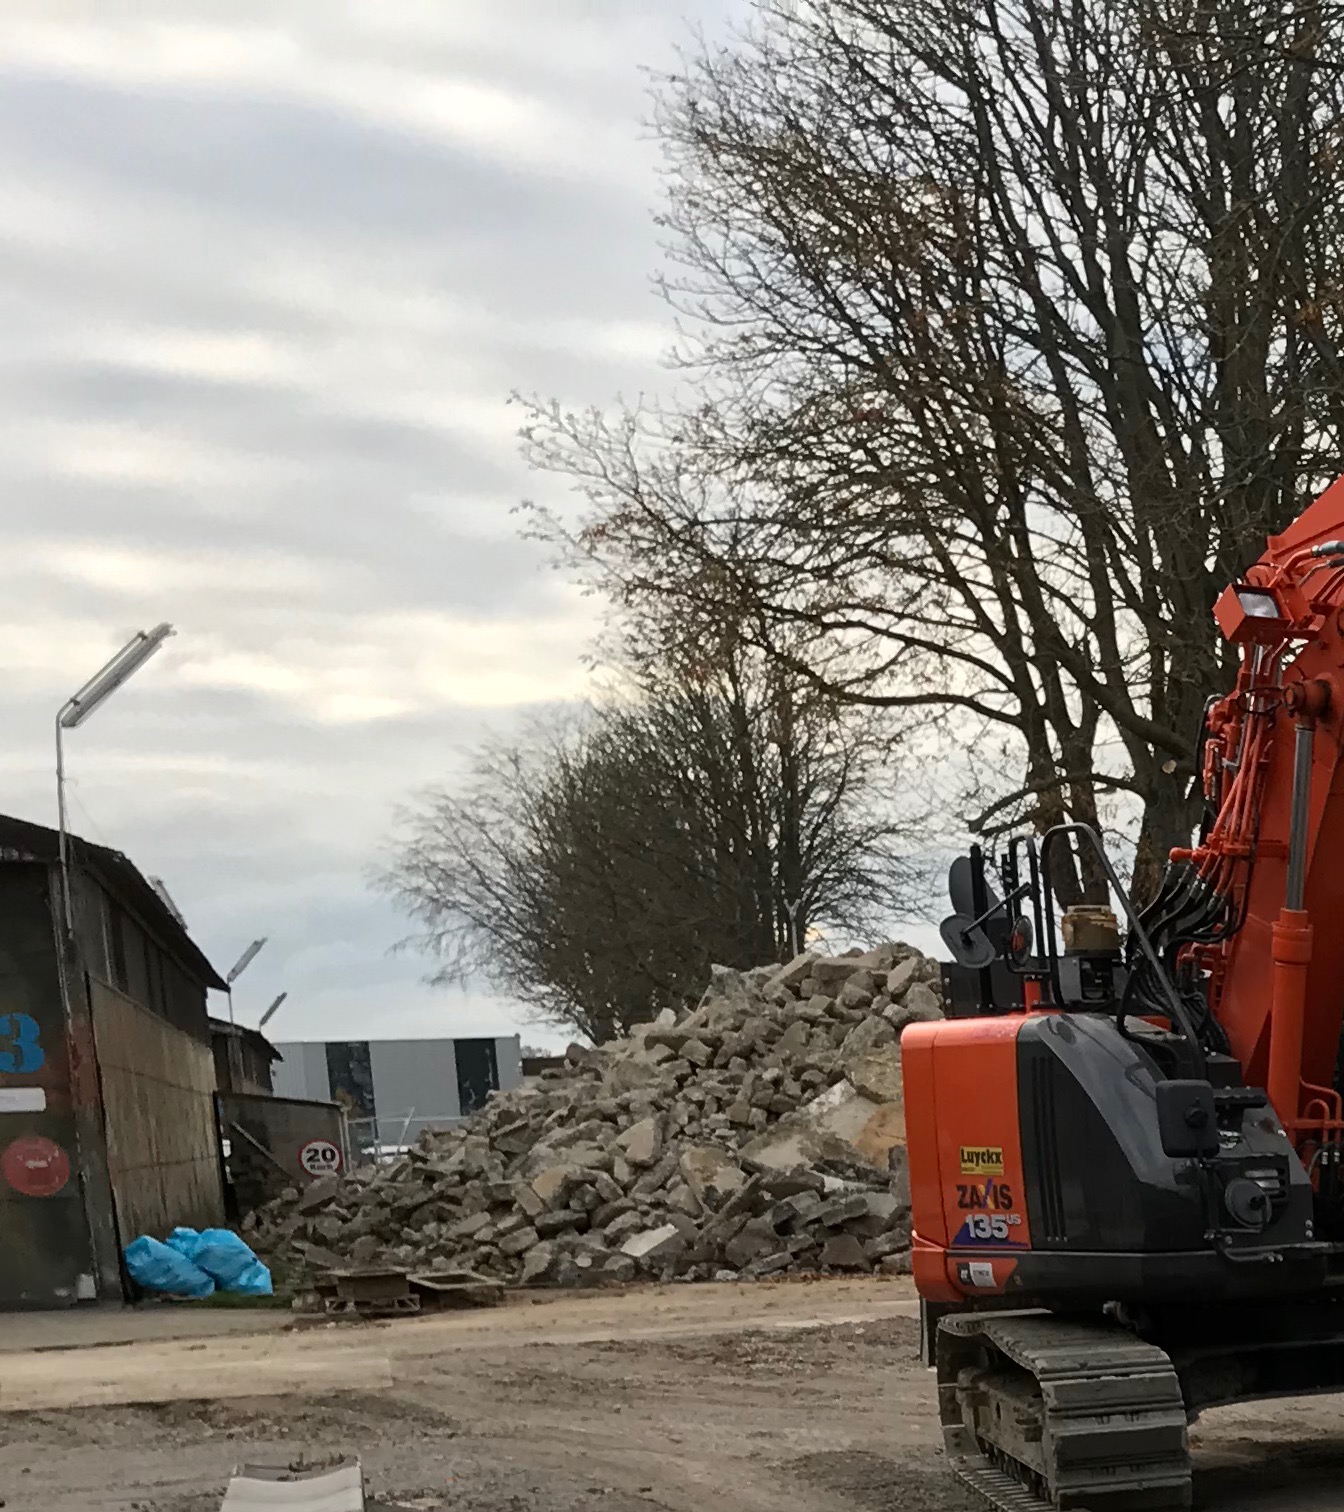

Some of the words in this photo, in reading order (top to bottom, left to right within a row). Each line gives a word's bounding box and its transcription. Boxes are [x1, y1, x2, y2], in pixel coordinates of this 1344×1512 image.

[306, 1147, 336, 1163] 20
[961, 1147, 1002, 1167] Luyckx
[956, 1176, 1013, 1210] ZAXIS
